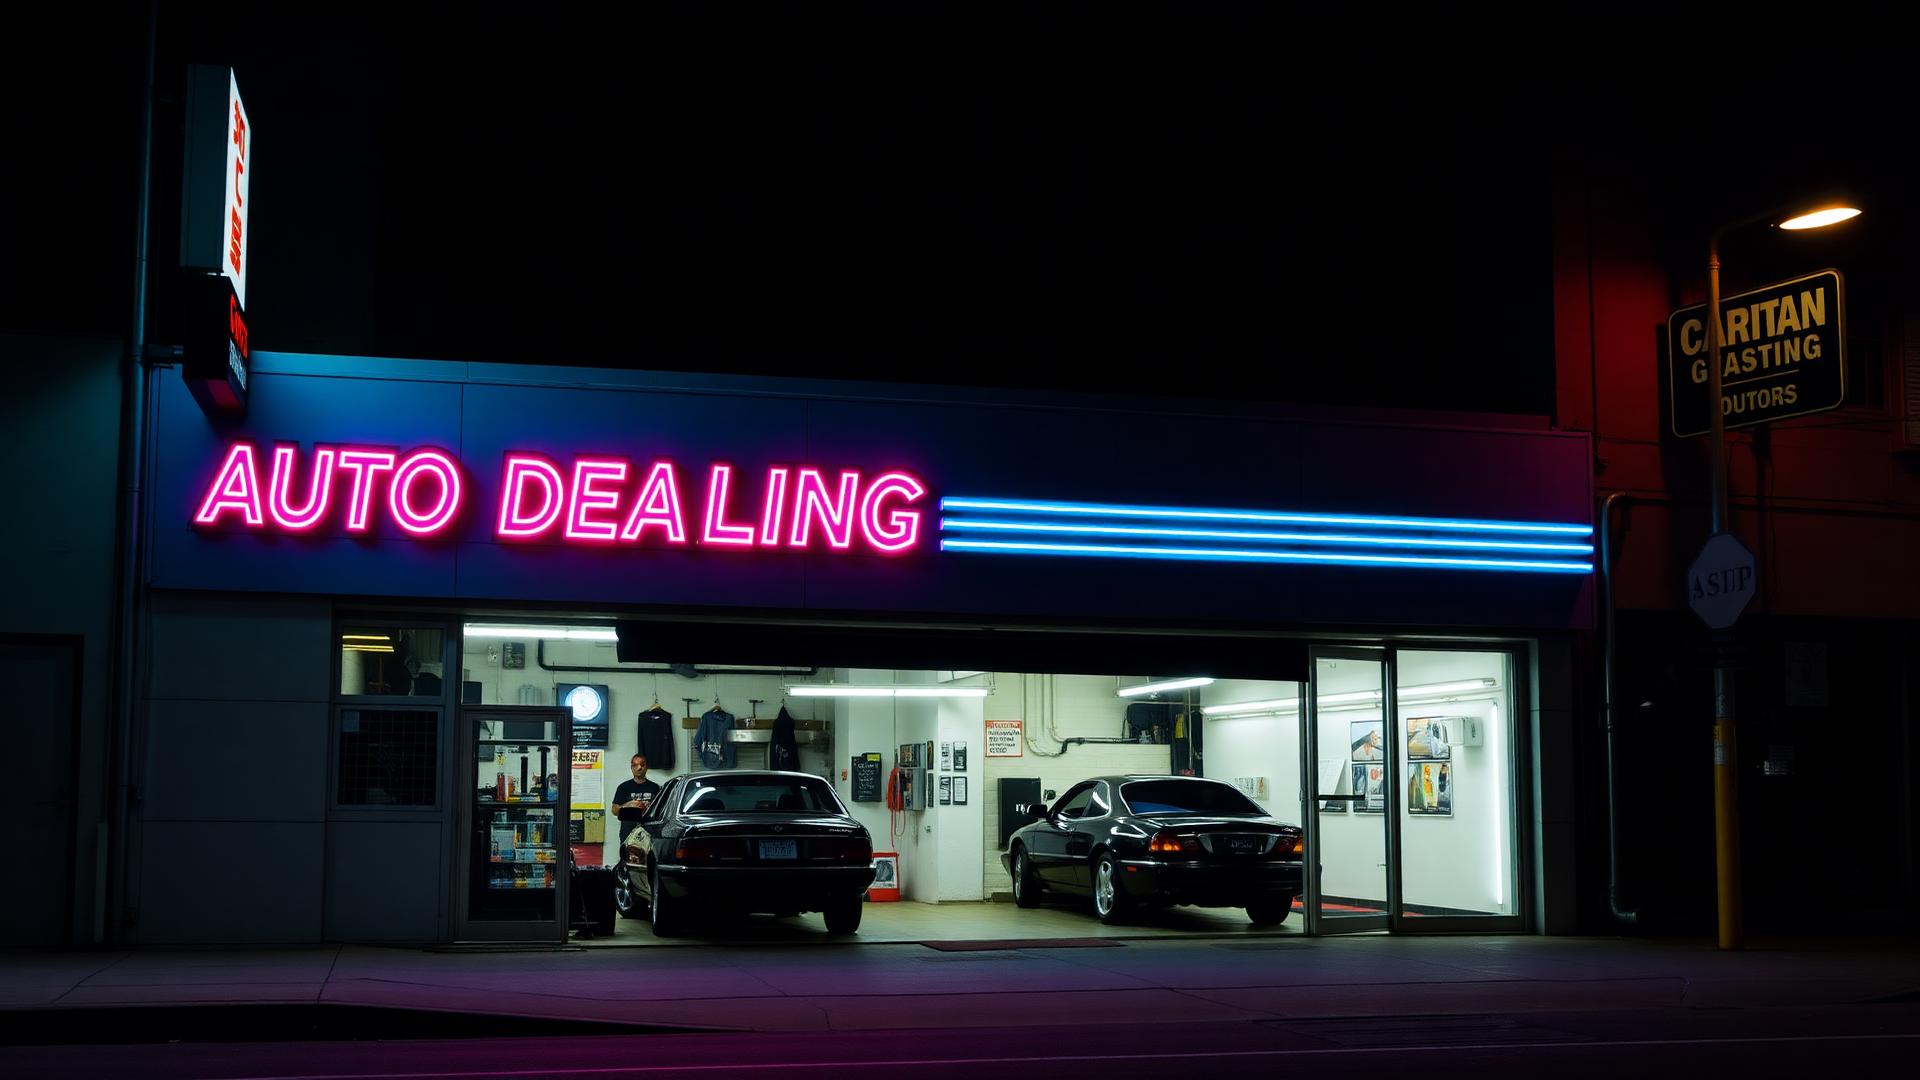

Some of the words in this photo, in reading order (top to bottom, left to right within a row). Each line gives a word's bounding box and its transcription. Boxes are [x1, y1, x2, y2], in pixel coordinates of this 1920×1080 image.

[1681, 288, 1825, 356] CARITAN
[1692, 335, 1821, 383] GASTING
[195, 444, 461, 535] AUTO
[498, 458, 924, 552] DEALING
